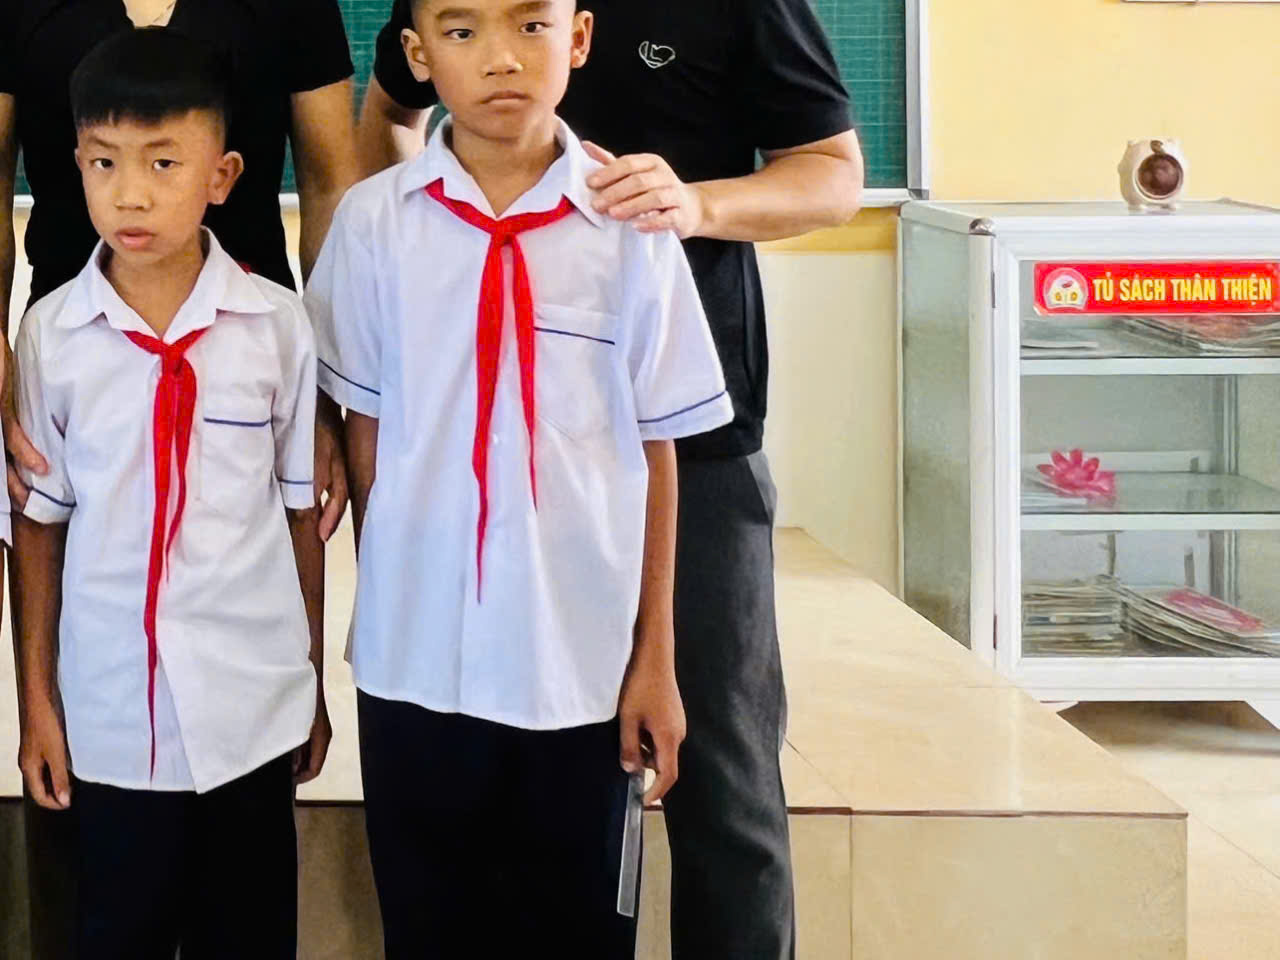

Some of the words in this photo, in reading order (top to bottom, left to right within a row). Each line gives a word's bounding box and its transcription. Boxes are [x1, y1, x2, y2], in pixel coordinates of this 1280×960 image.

[1092, 271, 1114, 301] TỦ
[1120, 274, 1166, 302] SÁCH
[1170, 273, 1217, 301] THÂN
[1221, 273, 1272, 306] THIỆN
